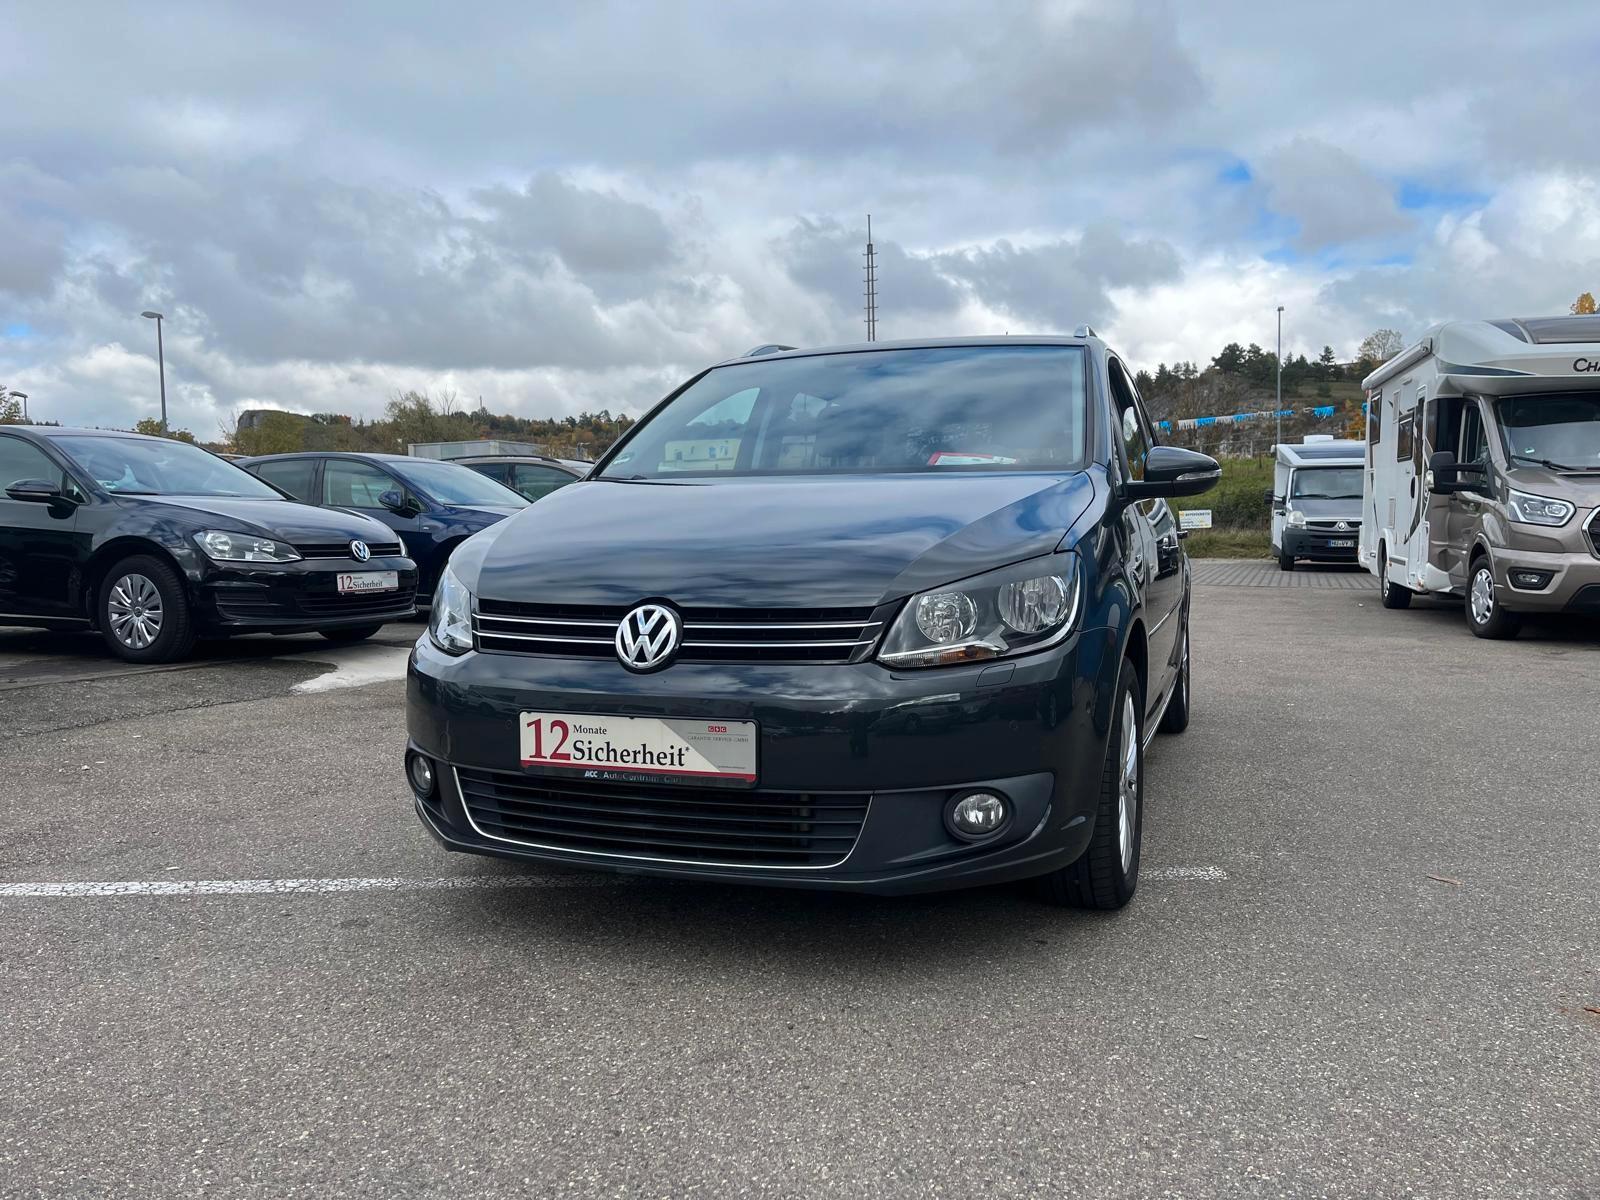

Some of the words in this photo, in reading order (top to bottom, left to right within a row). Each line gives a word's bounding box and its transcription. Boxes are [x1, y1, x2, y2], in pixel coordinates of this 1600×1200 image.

[339, 575, 353, 590] 12
[615, 604, 677, 669] VW
[573, 724, 607, 735] Monate
[526, 717, 571, 761] 12
[584, 770, 598, 779] ACC
